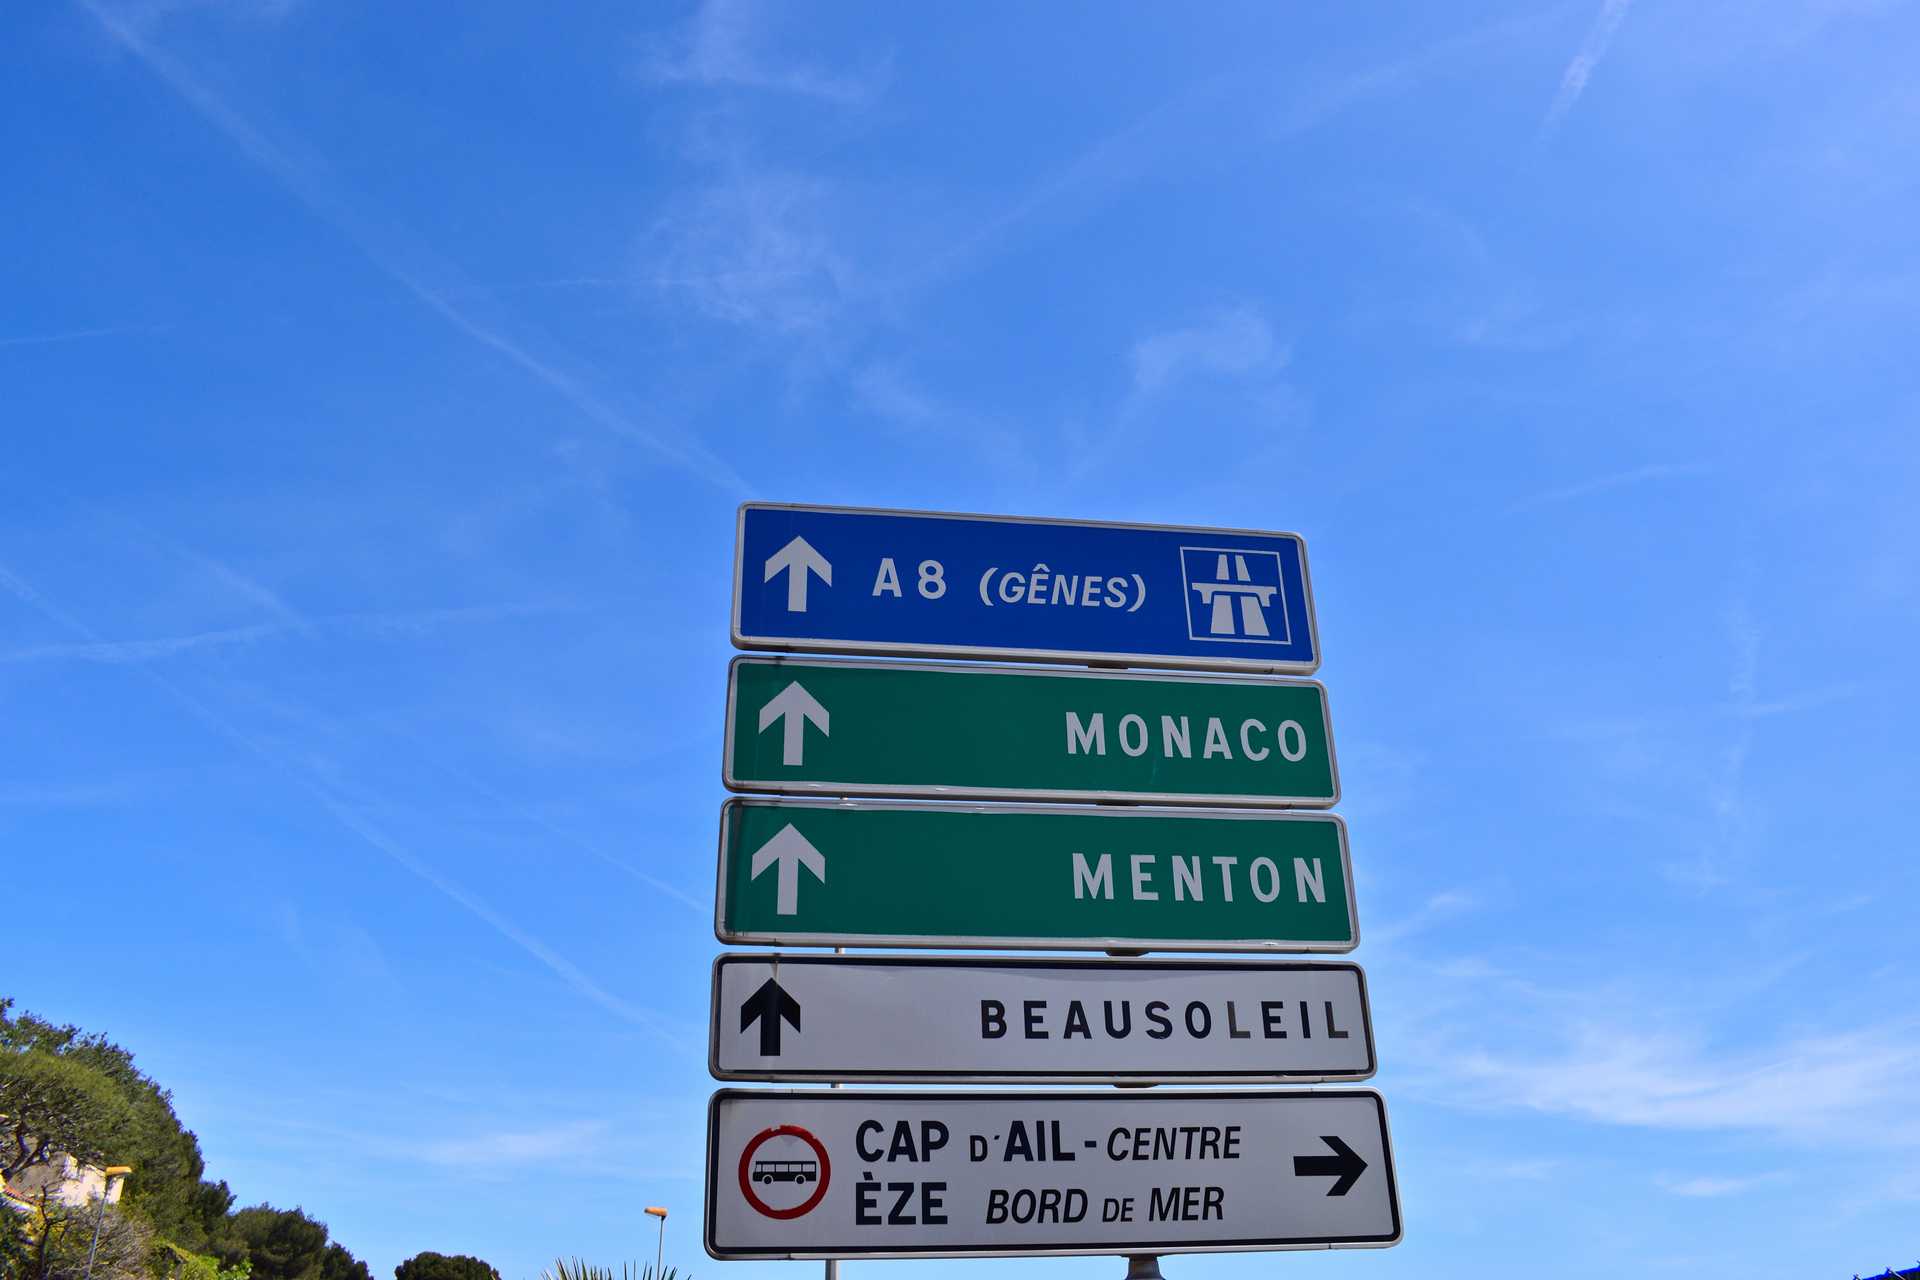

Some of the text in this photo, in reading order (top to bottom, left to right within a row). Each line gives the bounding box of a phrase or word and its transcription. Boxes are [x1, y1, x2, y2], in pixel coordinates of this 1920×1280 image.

[979, 563, 1146, 613] (GÊNES)
[1065, 711, 1307, 762] MONACO
[1072, 852, 1327, 903] MENTON
[980, 1000, 1349, 1040] BEAUSOLEIL
[855, 1119, 950, 1163] CAP
[855, 1171, 948, 1226] ÈZE
[985, 1186, 1225, 1225] BORD DE MER
